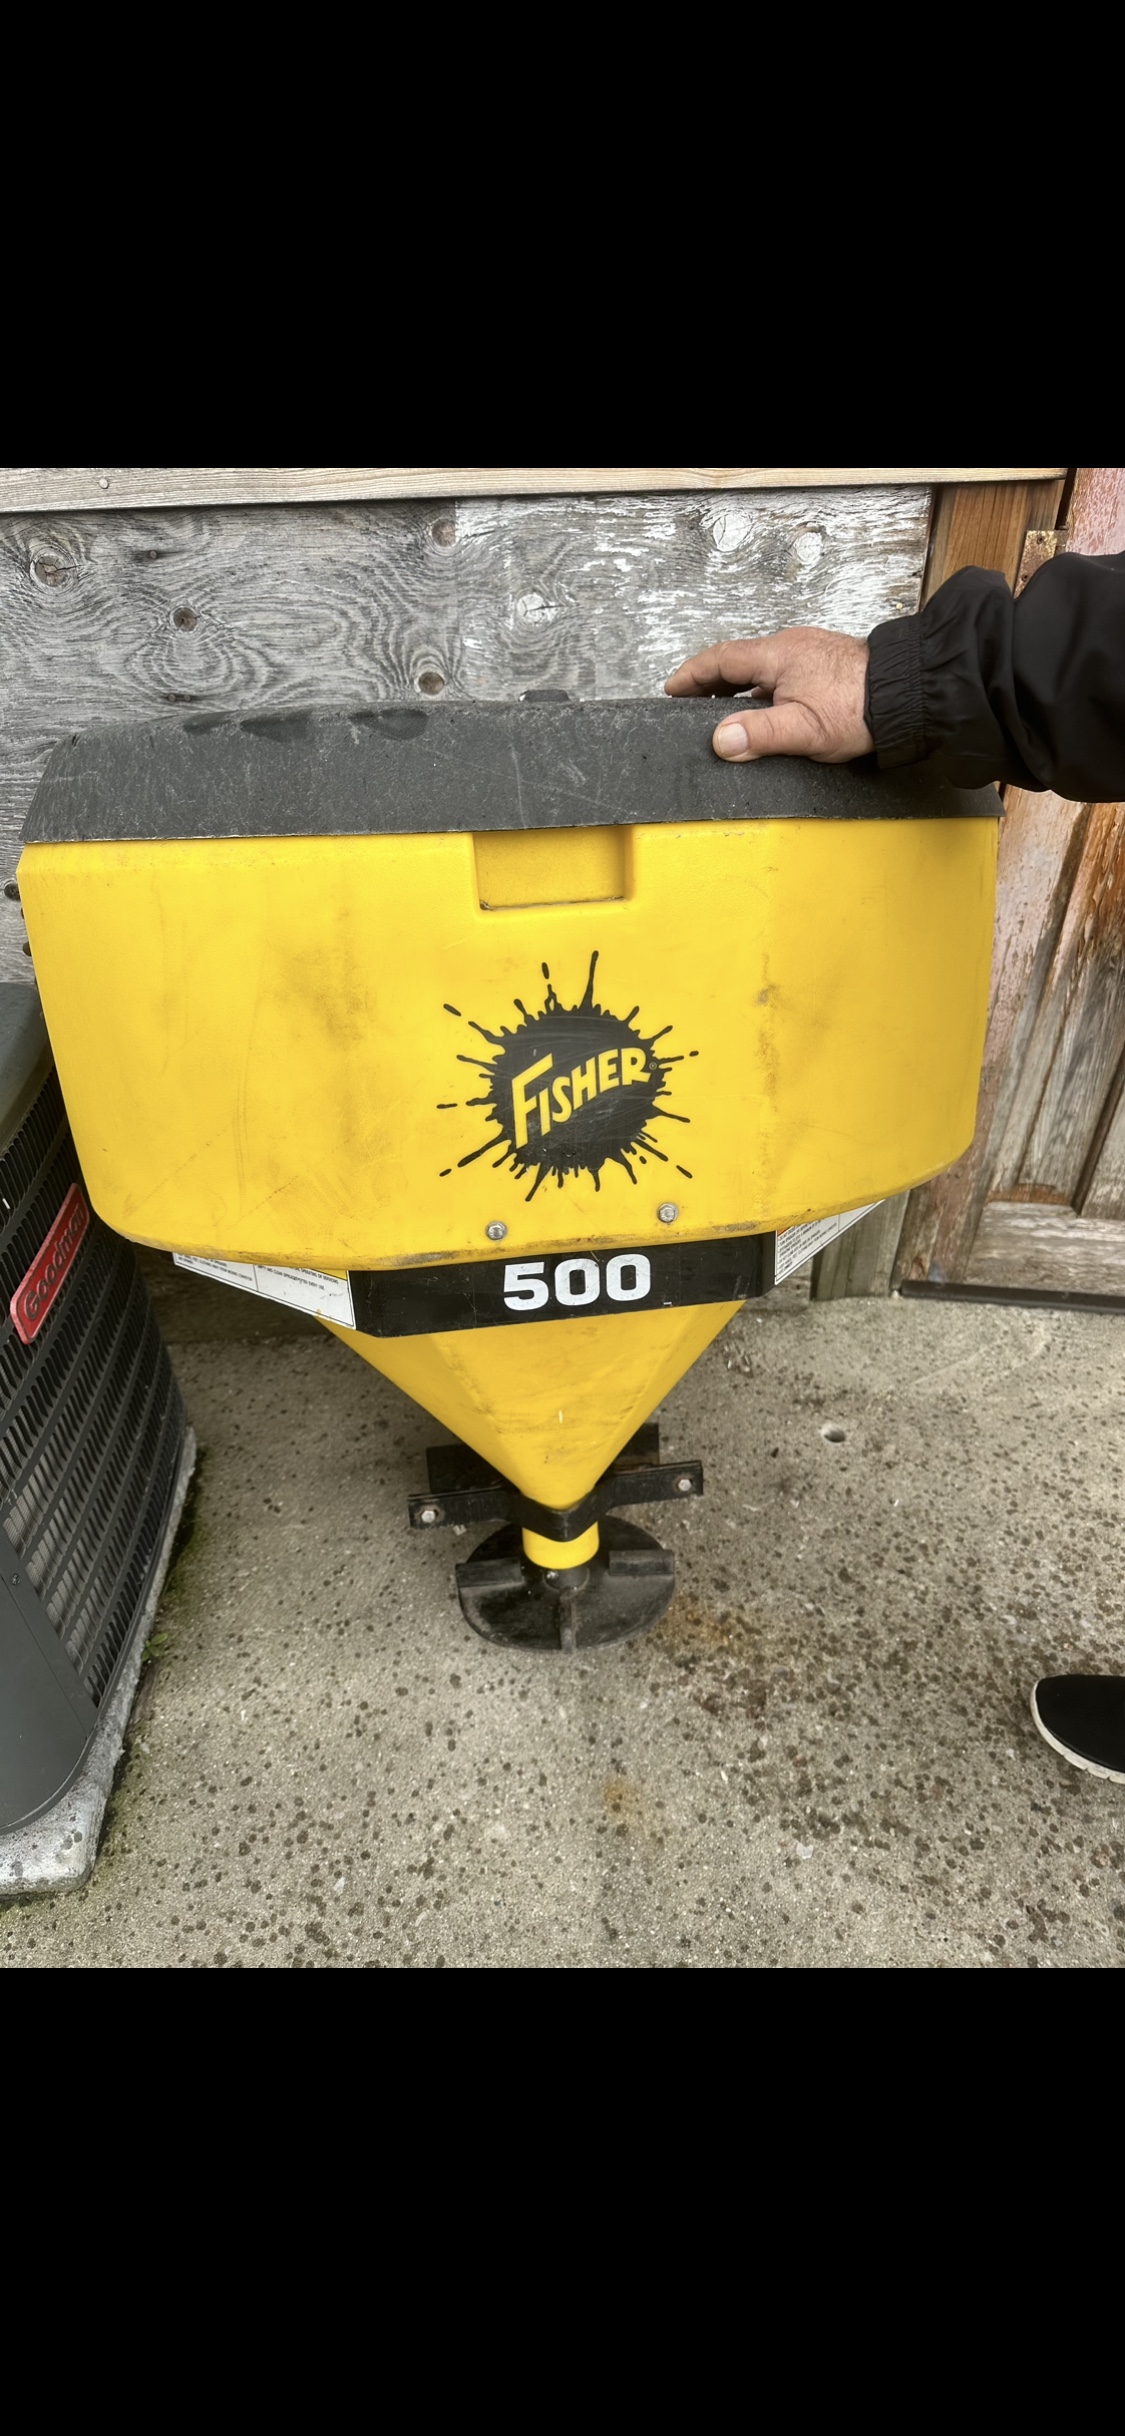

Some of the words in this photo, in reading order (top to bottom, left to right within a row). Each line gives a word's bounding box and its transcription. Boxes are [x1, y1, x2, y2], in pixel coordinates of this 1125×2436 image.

[512, 1046, 651, 1150] FISHER
[24, 1203, 84, 1321] Goodman
[503, 1253, 652, 1311] 500
